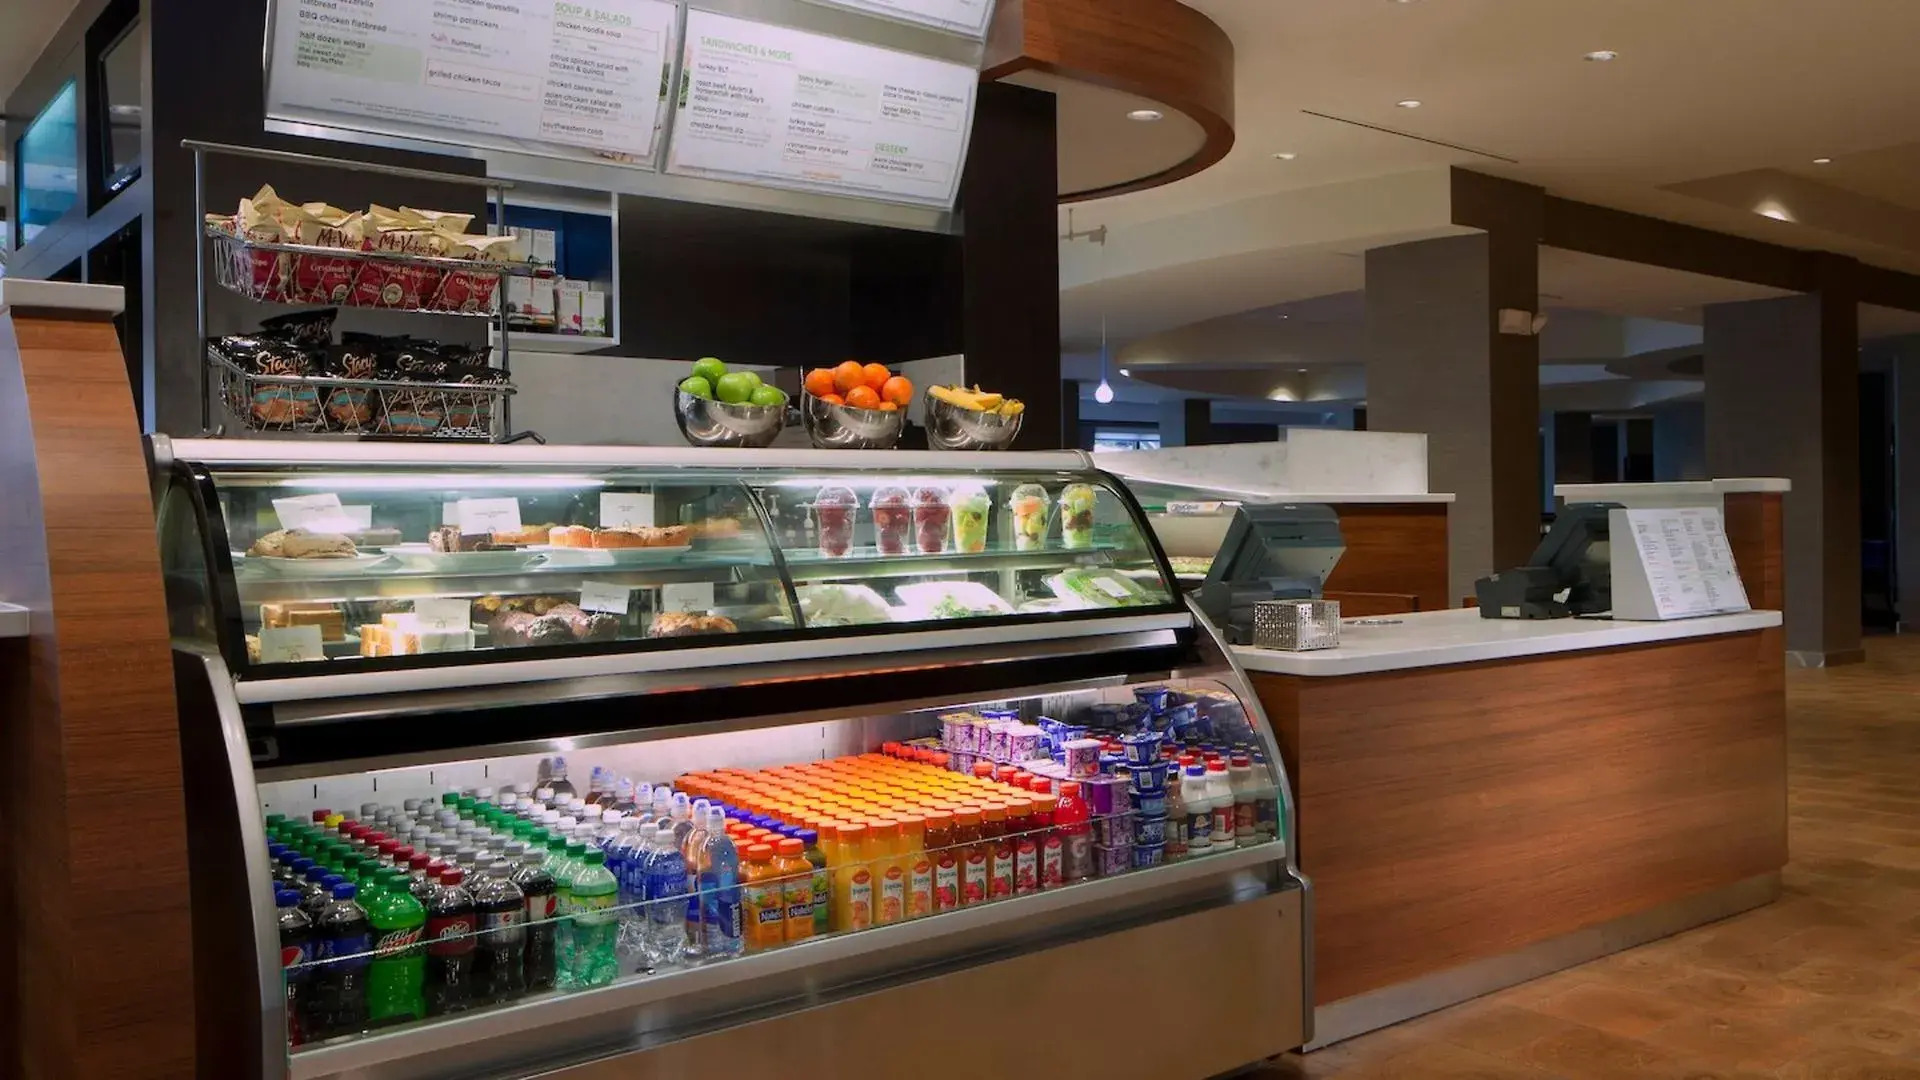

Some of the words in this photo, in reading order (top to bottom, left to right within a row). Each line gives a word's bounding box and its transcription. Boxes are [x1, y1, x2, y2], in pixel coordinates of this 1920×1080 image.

[299, 10, 317, 20] BBQ
[319, 14, 350, 26] chicken
[352, 19, 387, 32] flatbread
[555, 2, 582, 14] SOUP
[594, 10, 632, 26] SALADS
[701, 36, 758, 56] SANDWICHES
[768, 48, 793, 61] MORE
[256, 351, 308, 376] Stacy's
